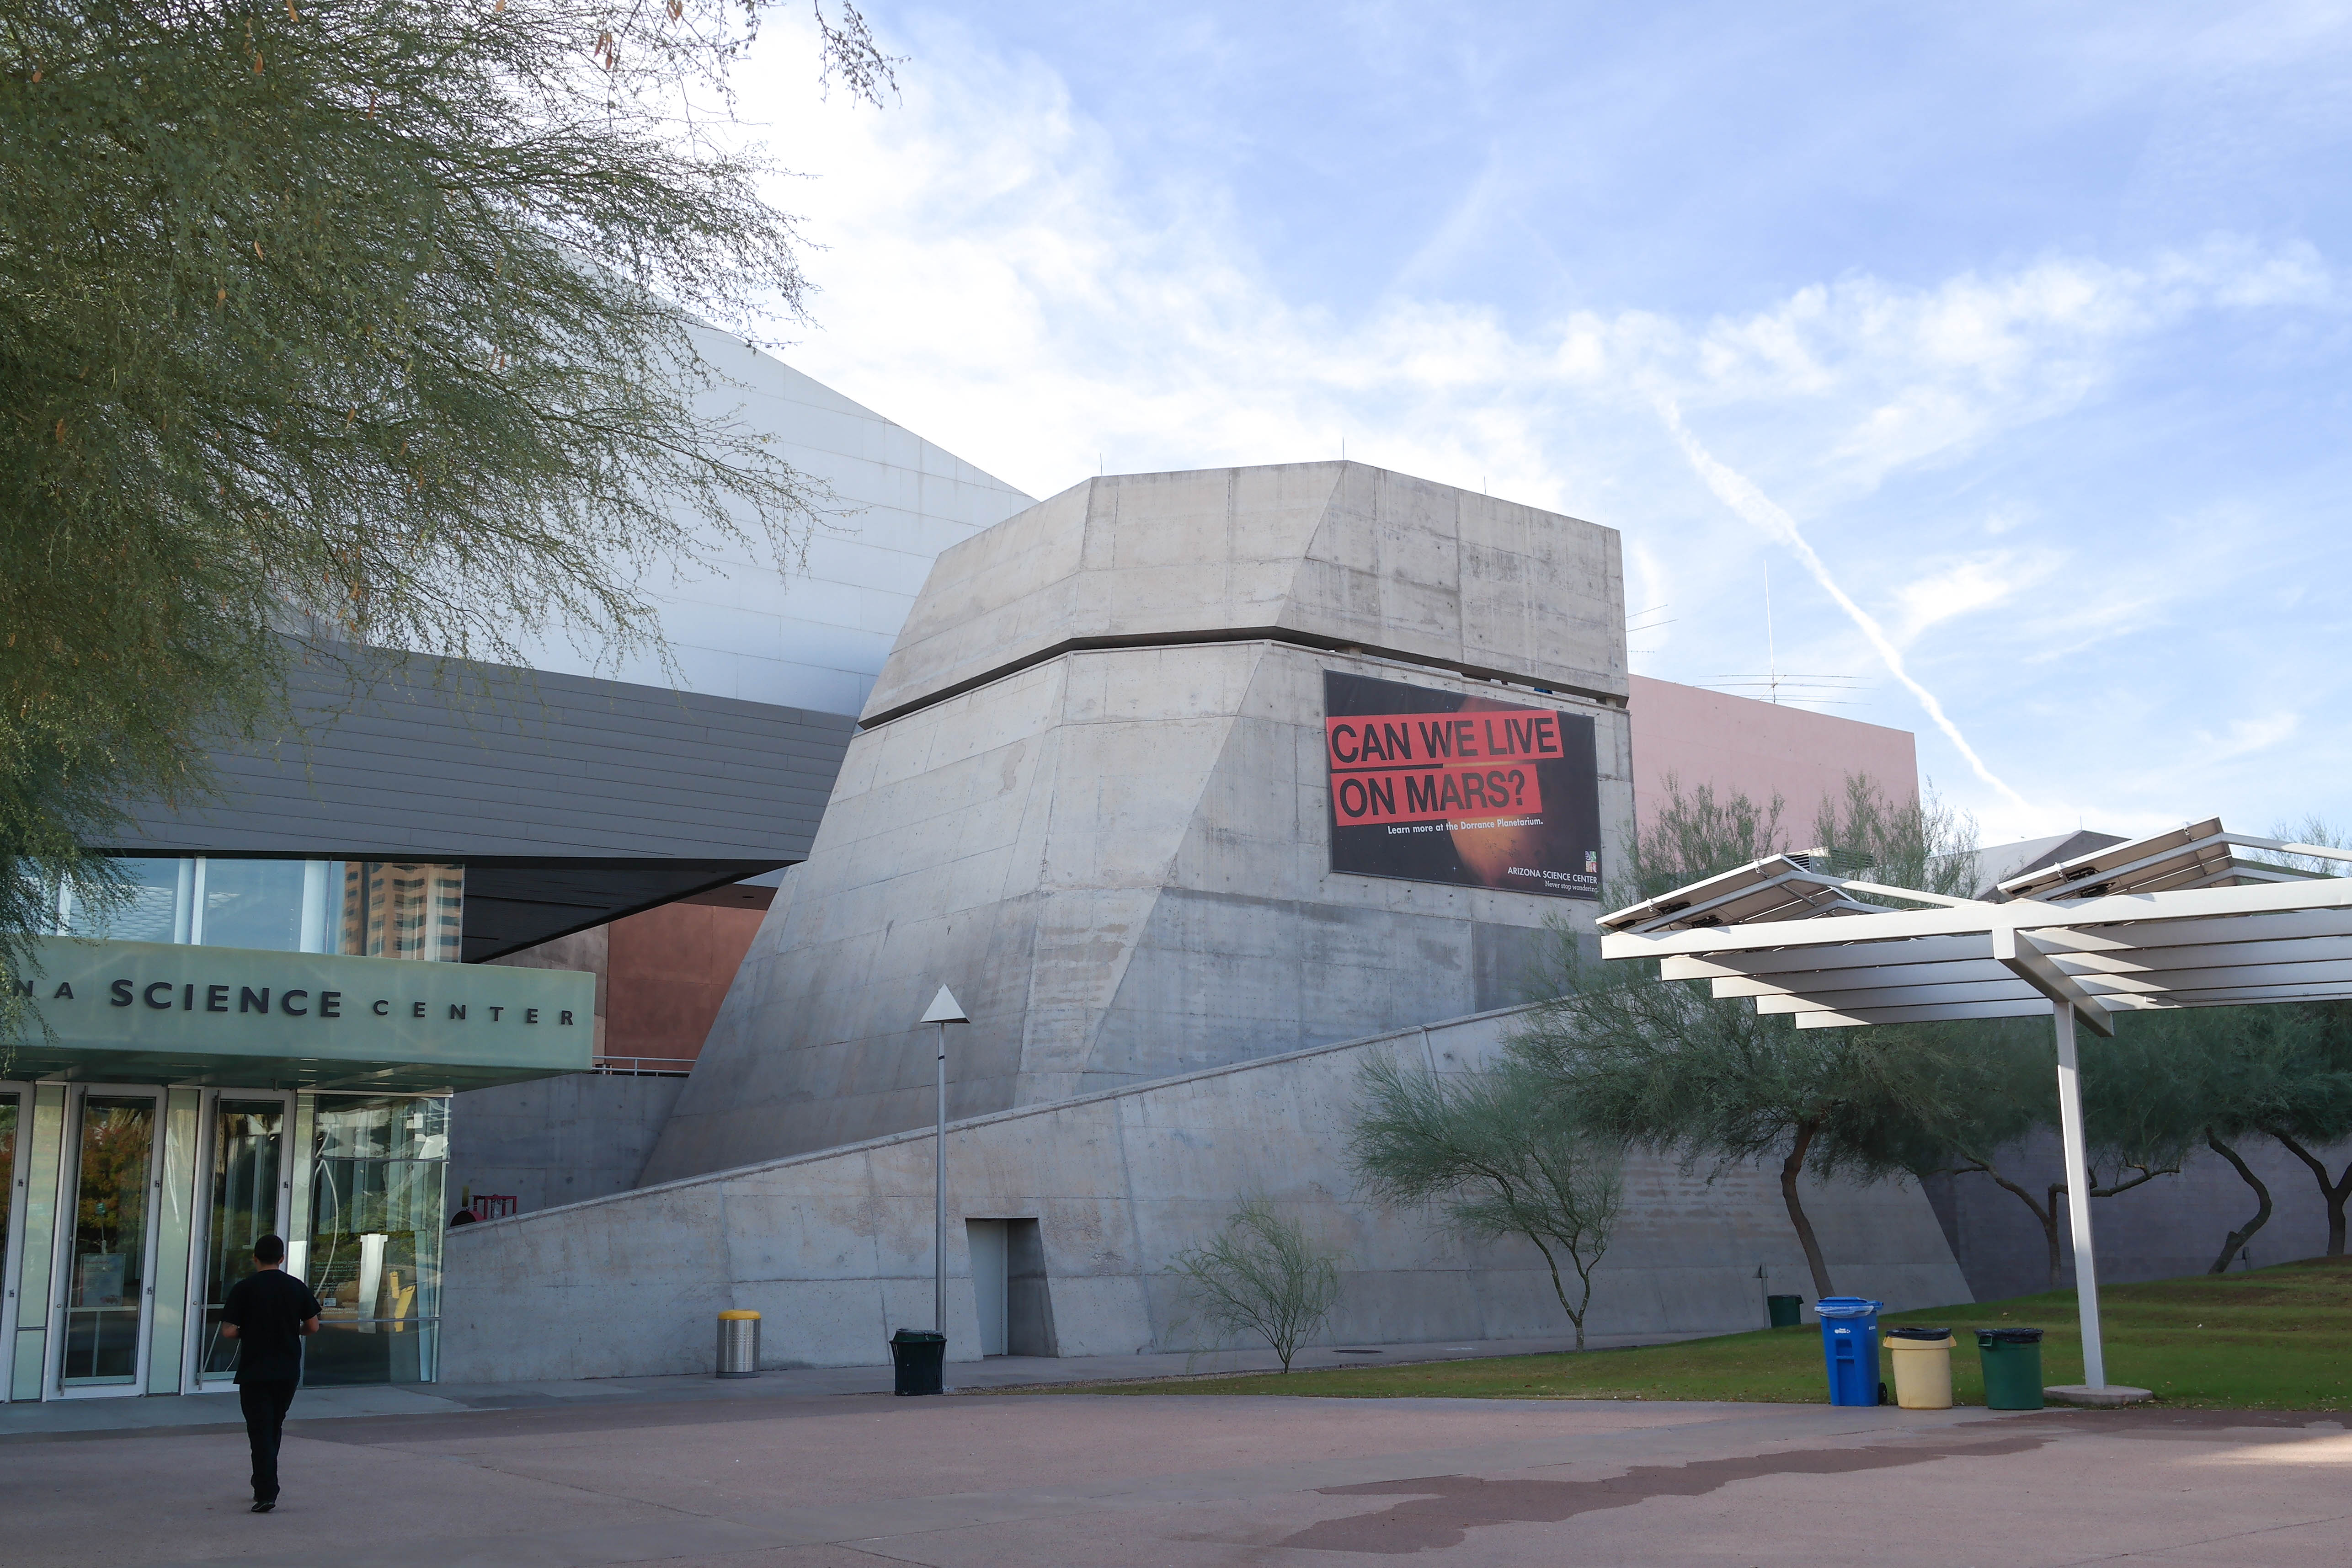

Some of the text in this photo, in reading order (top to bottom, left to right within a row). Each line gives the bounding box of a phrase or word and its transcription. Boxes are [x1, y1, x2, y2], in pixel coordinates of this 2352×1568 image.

[1331, 717, 1557, 763] CAN WE LIVE
[1339, 769, 1525, 818] ON MARS?
[1387, 826, 1409, 834] Learn
[1445, 822, 1458, 830] the
[1497, 817, 1543, 827] Planetarium.
[1508, 867, 1597, 884] ARIZONA SCIENCE CENTER
[109, 979, 341, 1019] SCIENCE
[372, 999, 574, 1025] CENTER
